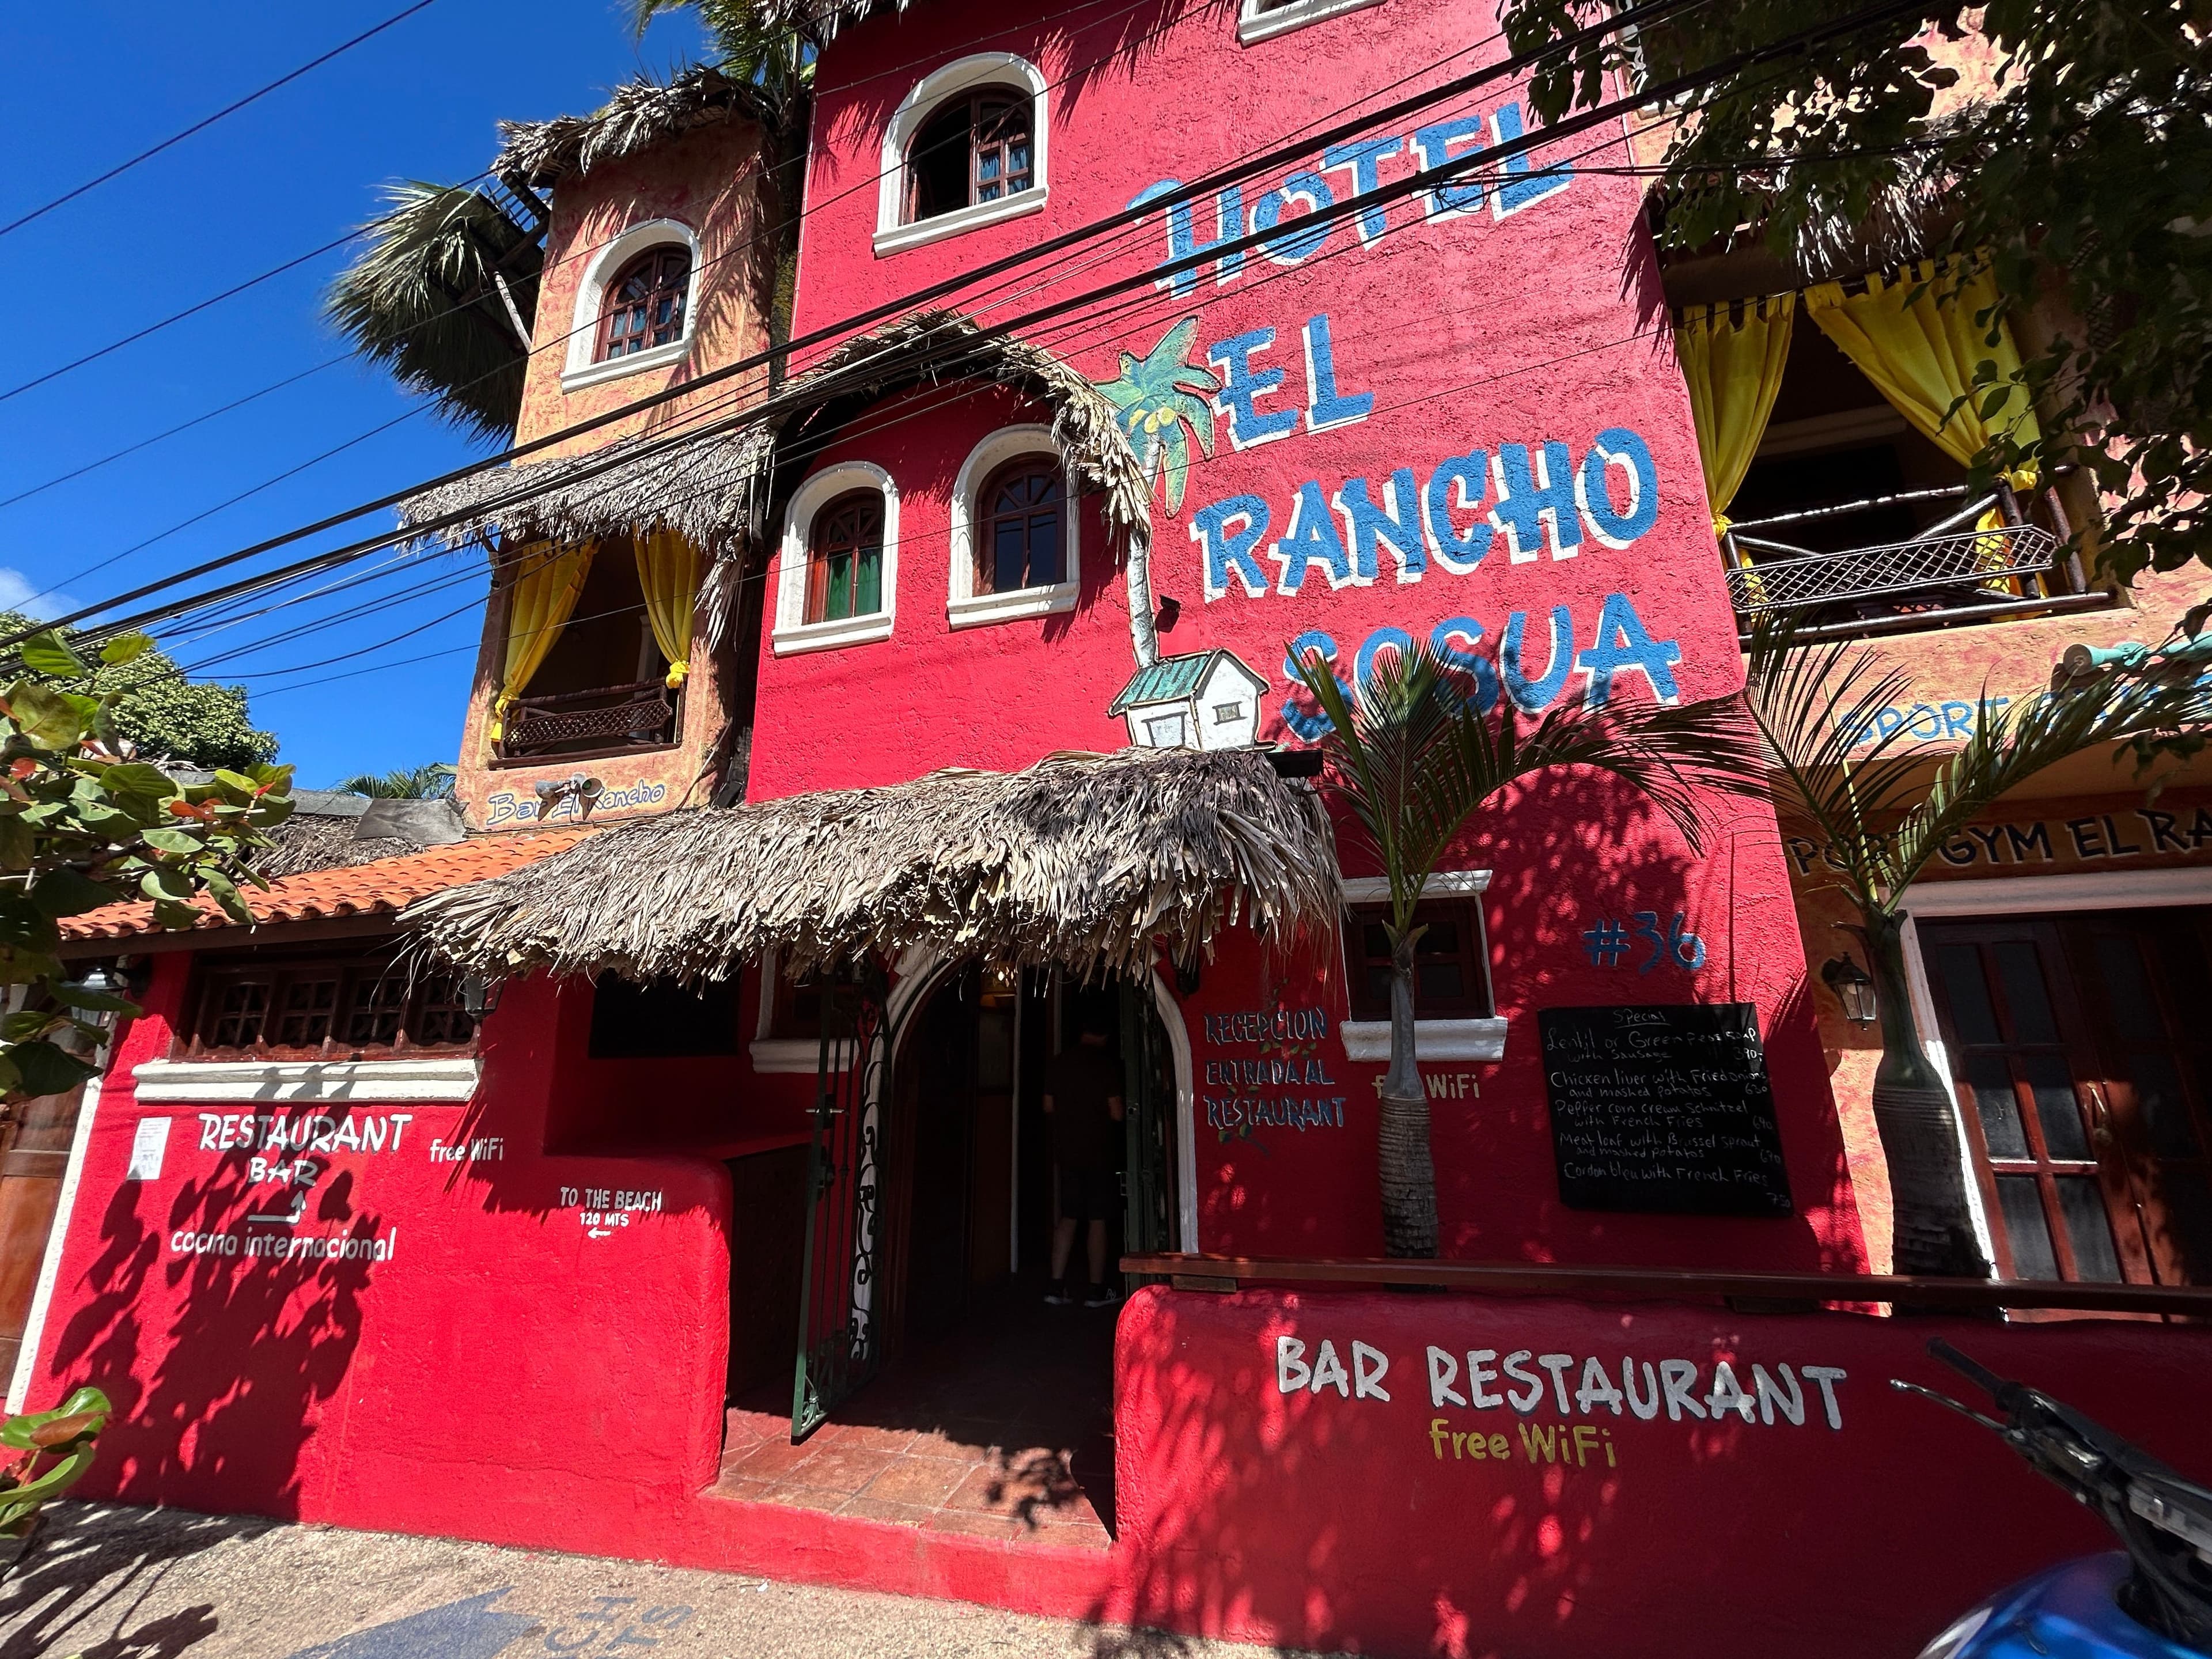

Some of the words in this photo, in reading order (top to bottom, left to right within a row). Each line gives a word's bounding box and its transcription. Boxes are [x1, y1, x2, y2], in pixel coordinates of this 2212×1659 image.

[1126, 102, 1575, 300] HOTEL
[1207, 313, 1374, 452] EL
[1189, 427, 1658, 603] RANCHO
[486, 793, 546, 825] Bar
[1936, 821, 2055, 868] GYM
[2065, 815, 2141, 861] EL
[1582, 910, 1706, 975] #36
[1203, 1006, 1327, 1046] RECEPCION
[1605, 1037, 1618, 1049] or
[1206, 1059, 1301, 1085] ENTRADA
[1304, 1059, 1335, 1085] AL
[1426, 1073, 1480, 1099] WiFi
[1551, 1070, 1611, 1088] Chicken
[1613, 1067, 1646, 1085] liver
[1652, 1068, 1687, 1083] with
[1569, 1088, 1593, 1098] and
[1599, 1086, 1651, 1097] mashed
[1203, 1094, 1346, 1132] RESTAURANT
[1574, 1115, 1605, 1127] with
[1612, 1115, 1661, 1127] French
[1642, 1103, 1682, 1114] cream
[197, 1113, 414, 1153] RESTAURANT
[1630, 1129, 1662, 1147] with
[430, 1138, 465, 1163] free
[471, 1137, 504, 1162] WiFi
[1576, 1146, 1596, 1157] and
[1599, 1146, 1646, 1158] mashed
[248, 1157, 318, 1187] BAR
[1642, 1162, 1672, 1180] with
[560, 1187, 578, 1207] TO
[585, 1188, 611, 1209] THE
[615, 1190, 662, 1212] BEACH
[579, 1212, 601, 1226] 120
[605, 1213, 630, 1227] MTS
[171, 1229, 237, 1256] cocina
[244, 1225, 397, 1262] internacional
[1275, 1335, 1391, 1403] BAR
[1425, 1344, 1848, 1431] RESTAURANT
[1428, 1418, 1511, 1461] free
[1517, 1421, 1618, 1468] WiFi
